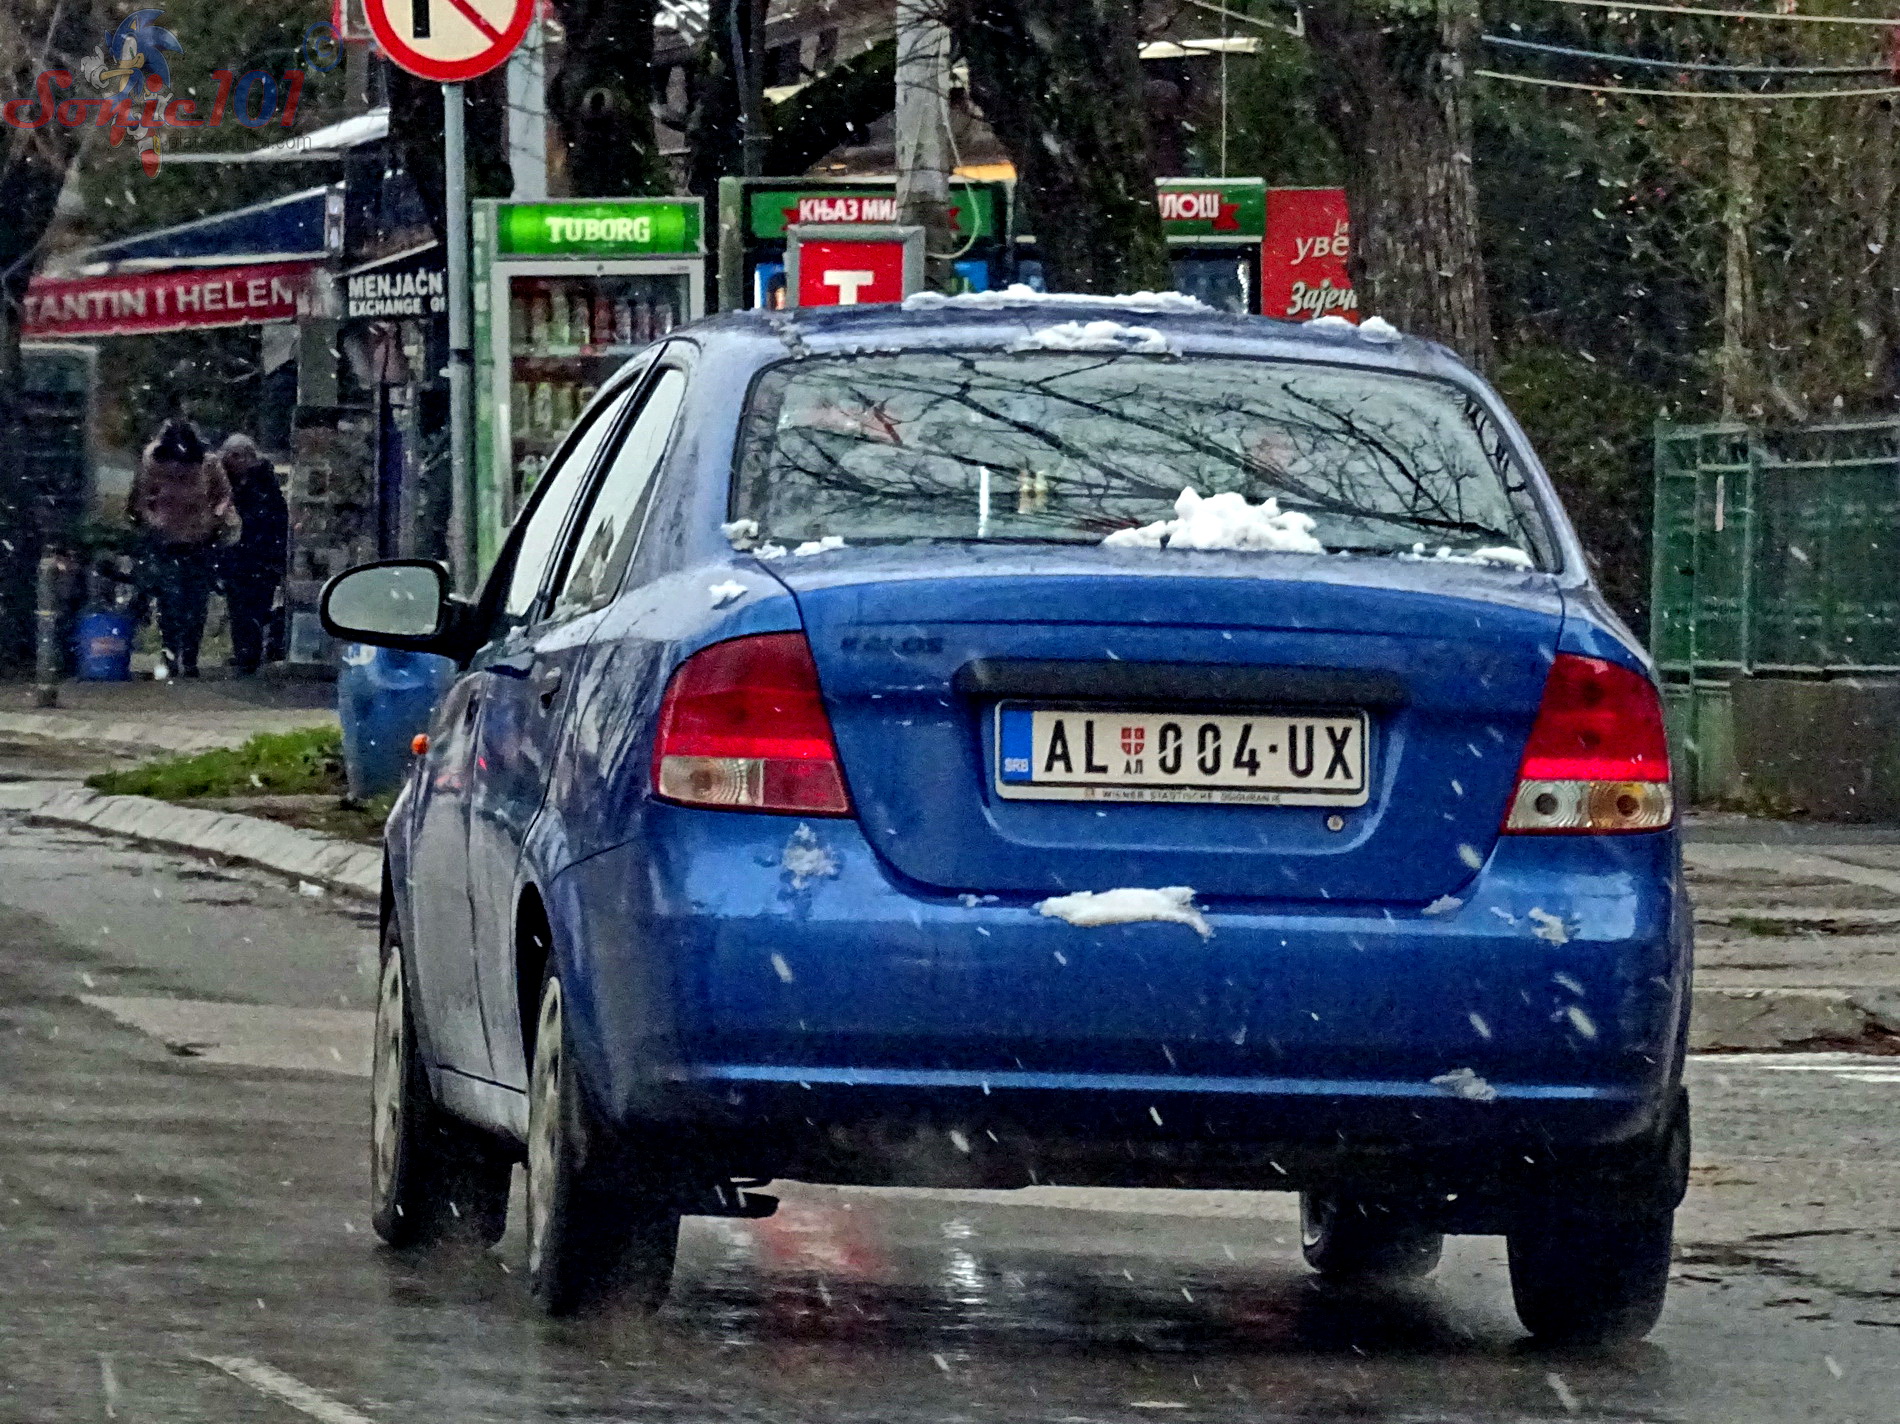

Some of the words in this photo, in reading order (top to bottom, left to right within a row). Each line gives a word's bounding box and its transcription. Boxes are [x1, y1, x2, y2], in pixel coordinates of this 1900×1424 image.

[799, 198, 859, 222] КЊАЗ
[1158, 193, 1220, 219] ЛОШ
[545, 216, 651, 244] TUBORG
[348, 297, 422, 317] EXCHANGE
[1044, 719, 1108, 774] AL
[1004, 758, 1029, 773] SRB
[1123, 760, 1144, 775] АЛ
